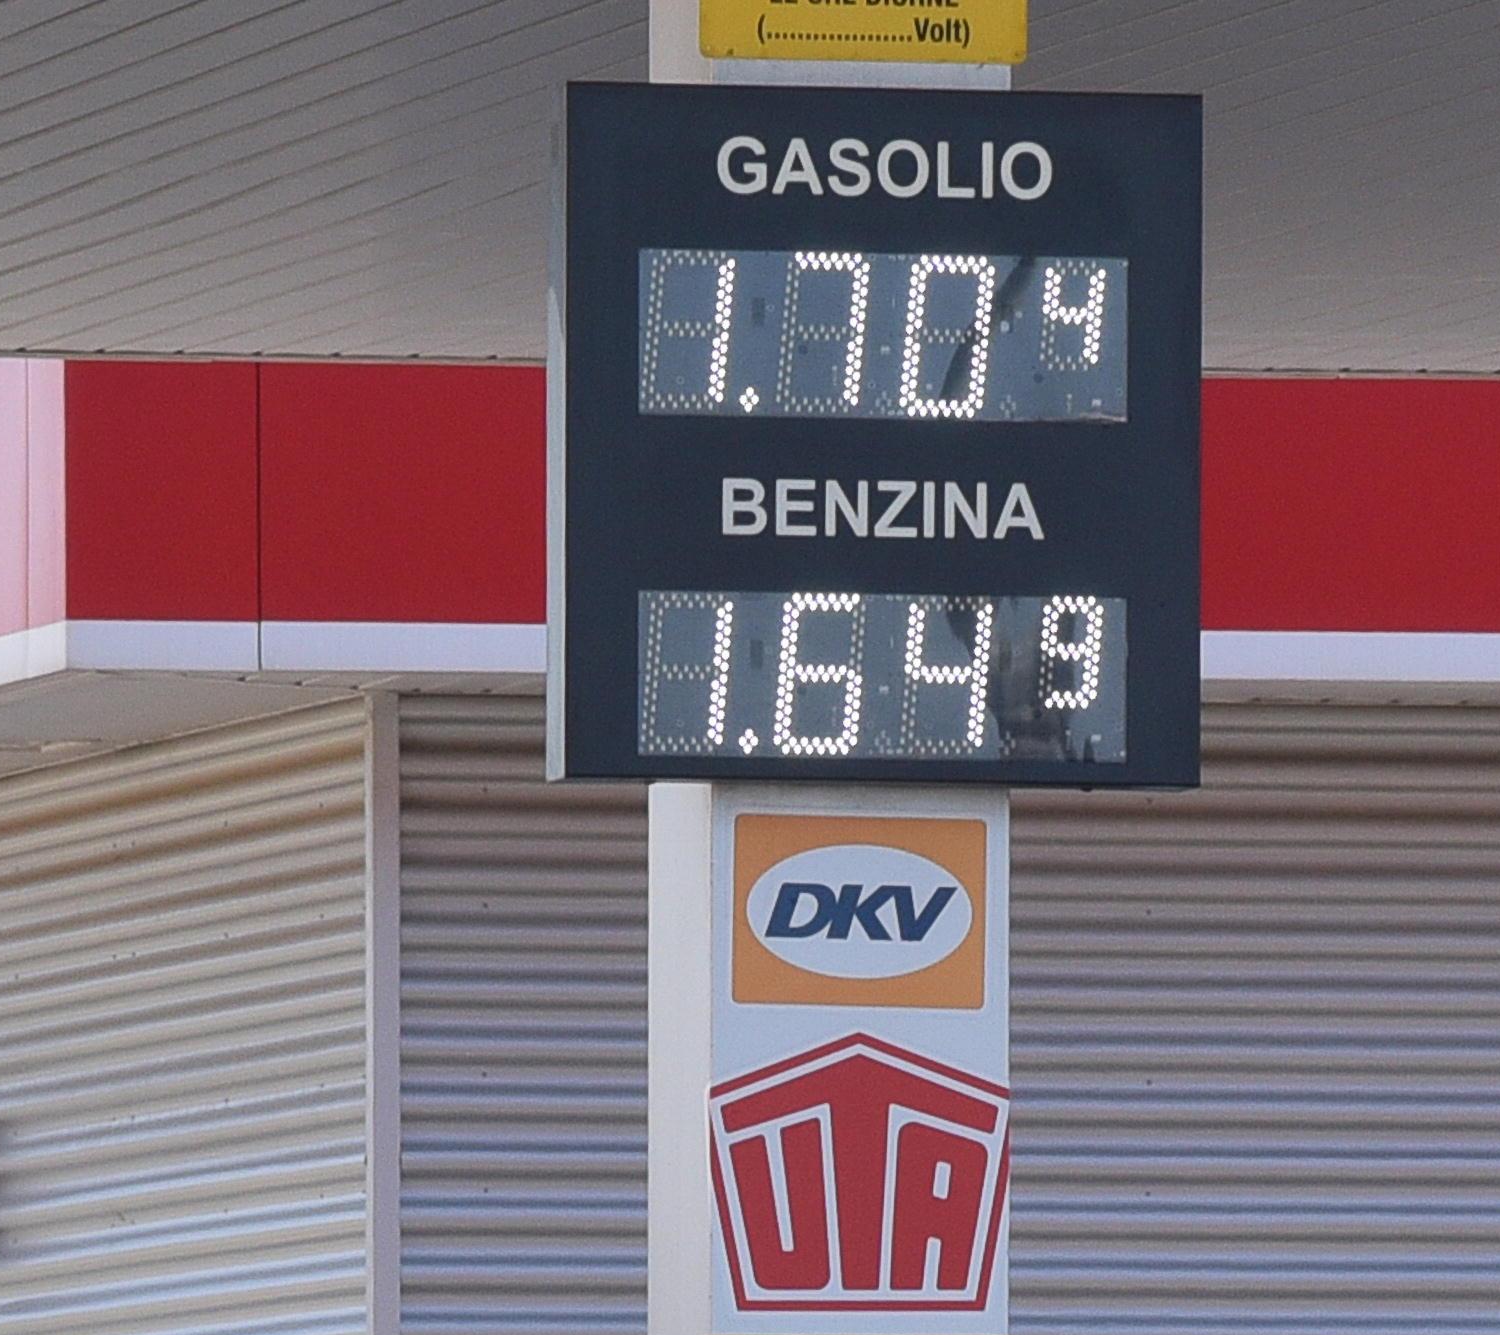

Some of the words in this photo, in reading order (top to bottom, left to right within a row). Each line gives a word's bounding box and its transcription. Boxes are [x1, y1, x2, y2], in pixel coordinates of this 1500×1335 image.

[717, 136, 1052, 199] GASOLIO
[708, 251, 1105, 418] 1.704
[722, 478, 1044, 539] BENZINA
[707, 593, 1103, 754] 1.649
[765, 882, 958, 941] DKV
[721, 1053, 999, 1290] UTA
